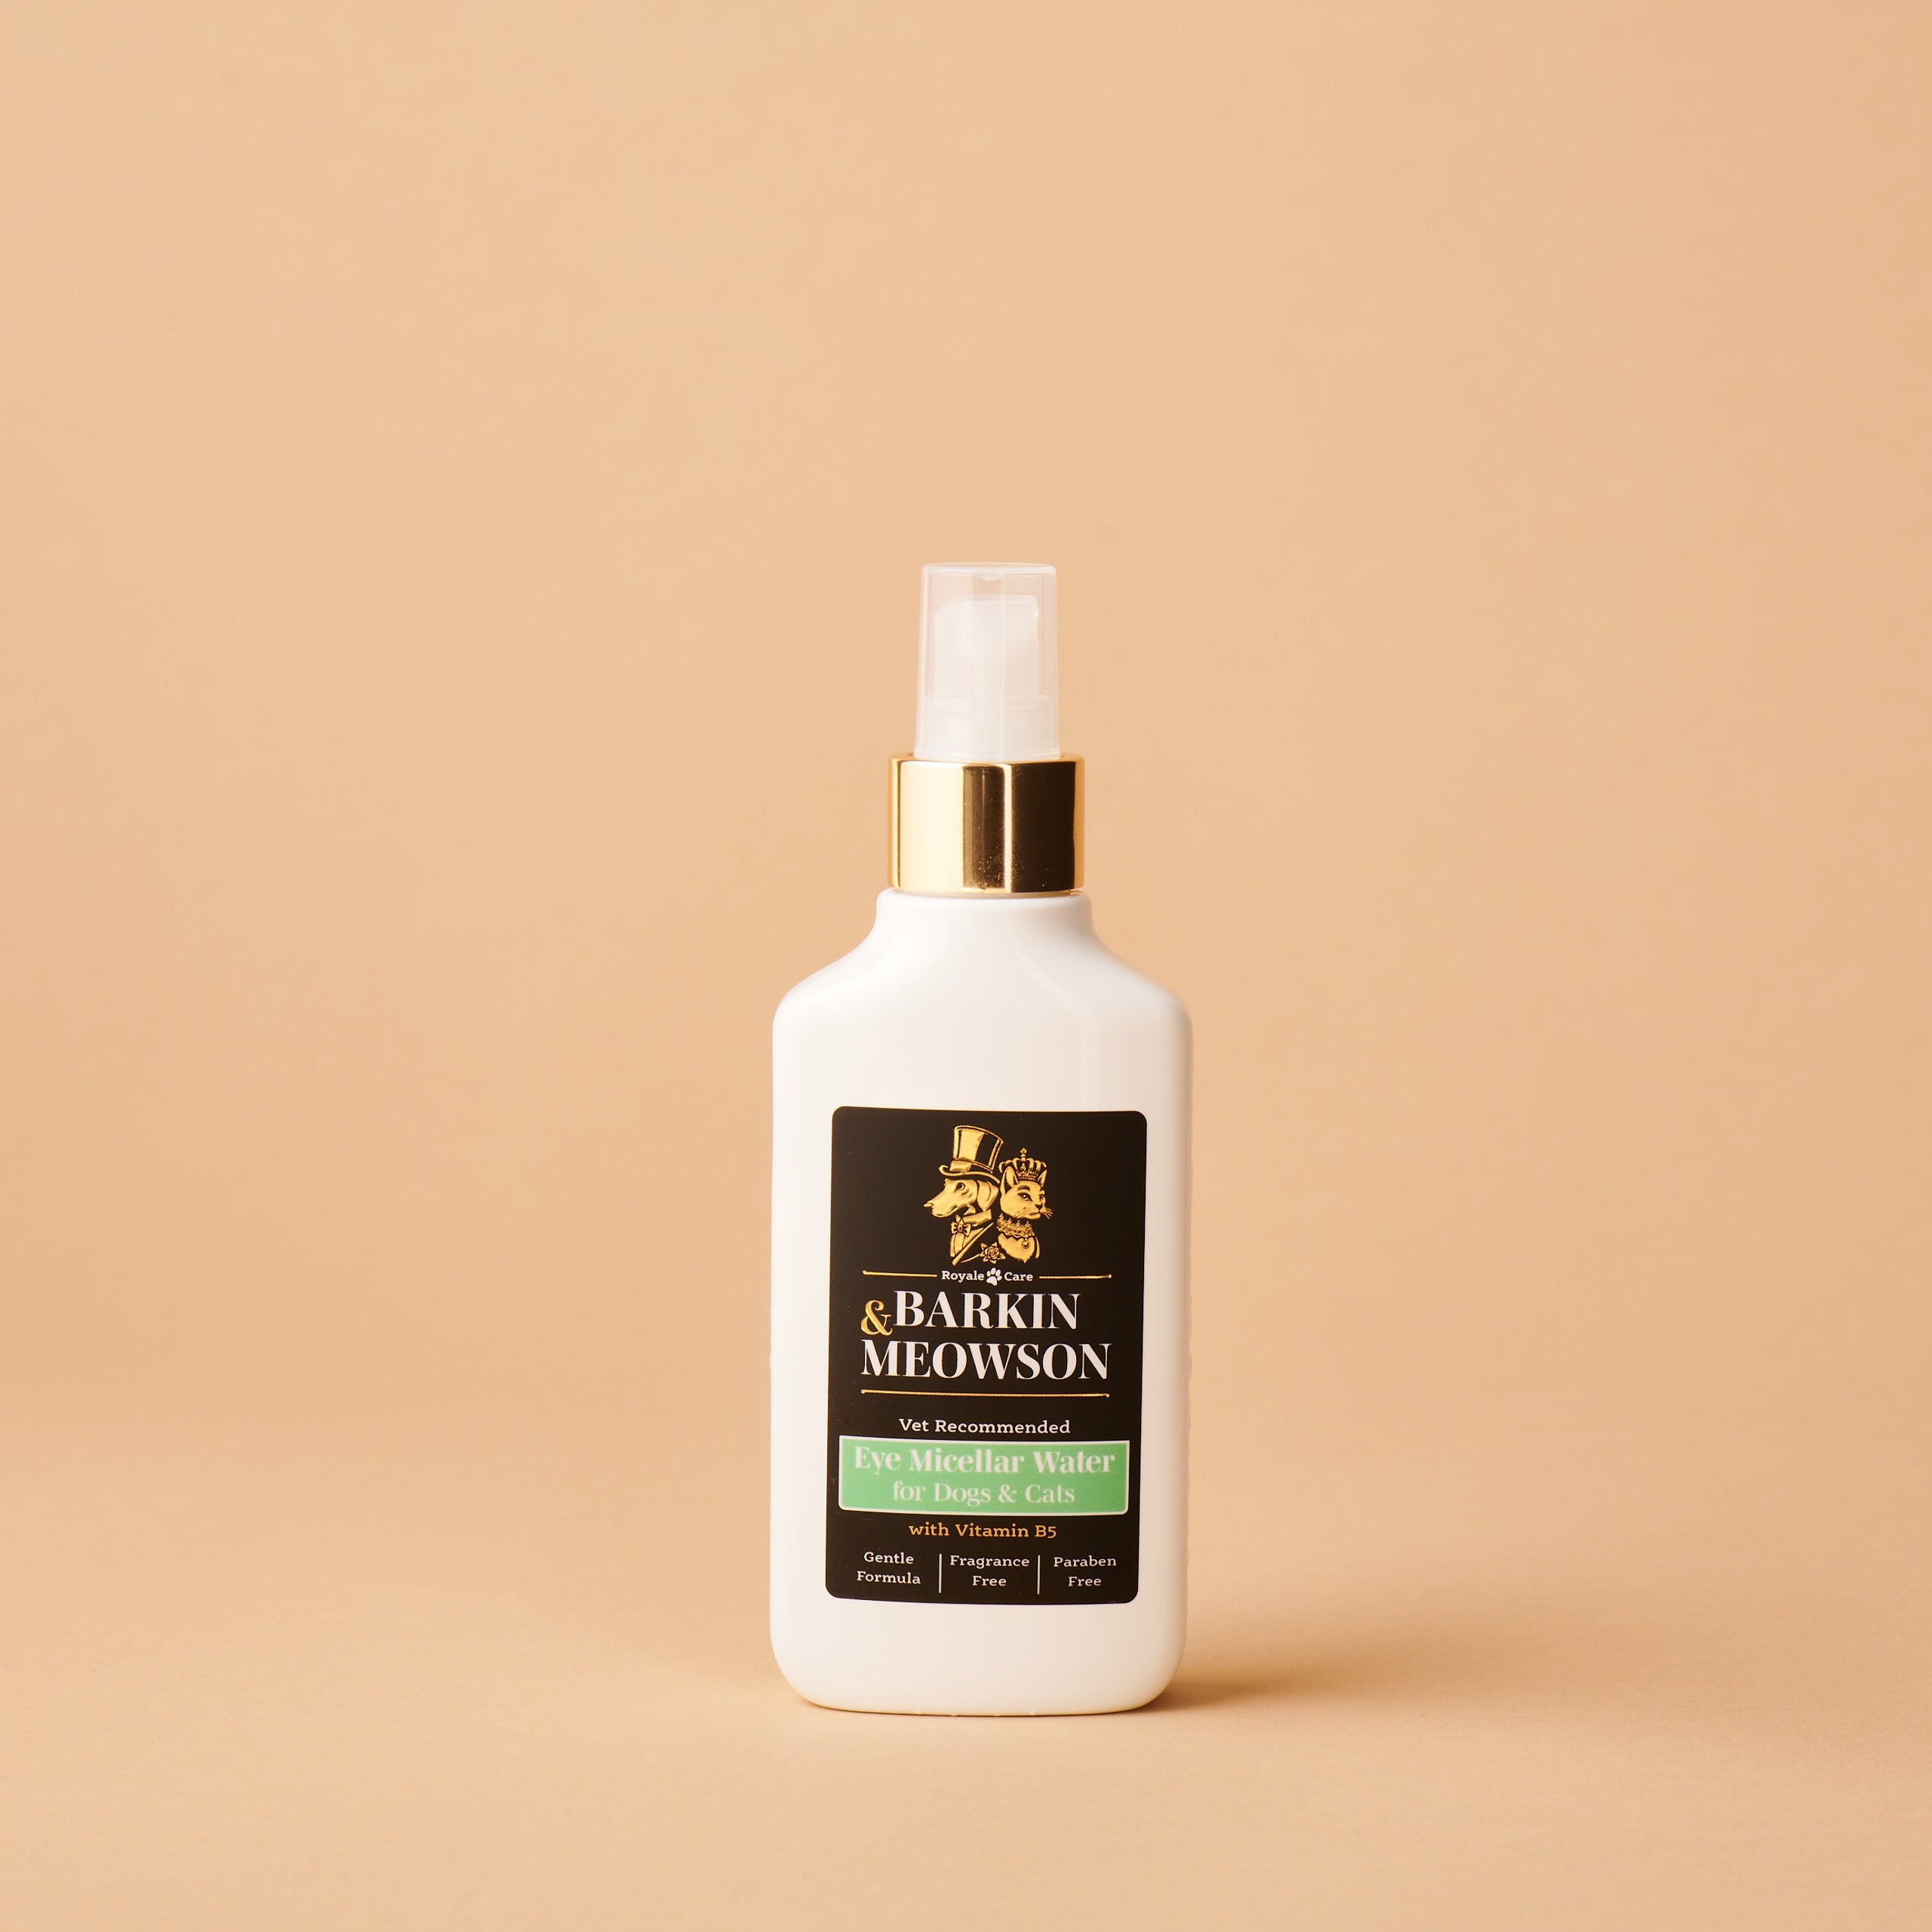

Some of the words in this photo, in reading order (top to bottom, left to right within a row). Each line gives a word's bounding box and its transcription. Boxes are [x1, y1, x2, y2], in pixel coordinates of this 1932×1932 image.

[942, 1270, 984, 1282] Royale
[1004, 1272, 1033, 1281] Care
[861, 1300, 892, 1335] &
[894, 1291, 1079, 1329] BARKIN
[861, 1340, 1110, 1380] MEOWSON
[899, 1419, 928, 1432] Vet
[935, 1420, 1070, 1433] Recommended
[856, 1447, 901, 1475] Eye
[909, 1448, 1024, 1473] Micellar
[1033, 1451, 1115, 1473] Water
[894, 1481, 926, 1500] for
[934, 1483, 991, 1506] Dogs
[998, 1484, 1017, 1503] &
[1026, 1485, 1075, 1503] Cats
[909, 1521, 949, 1536] with
[955, 1523, 1029, 1537] Vitamin
[1035, 1525, 1056, 1538] B5
[864, 1552, 913, 1564] Gentle
[950, 1555, 1029, 1569] Fragrance
[1054, 1555, 1116, 1567] Paraben
[857, 1571, 921, 1584] Formula
[973, 1576, 1006, 1586] Free
[1069, 1577, 1101, 1586] Free
